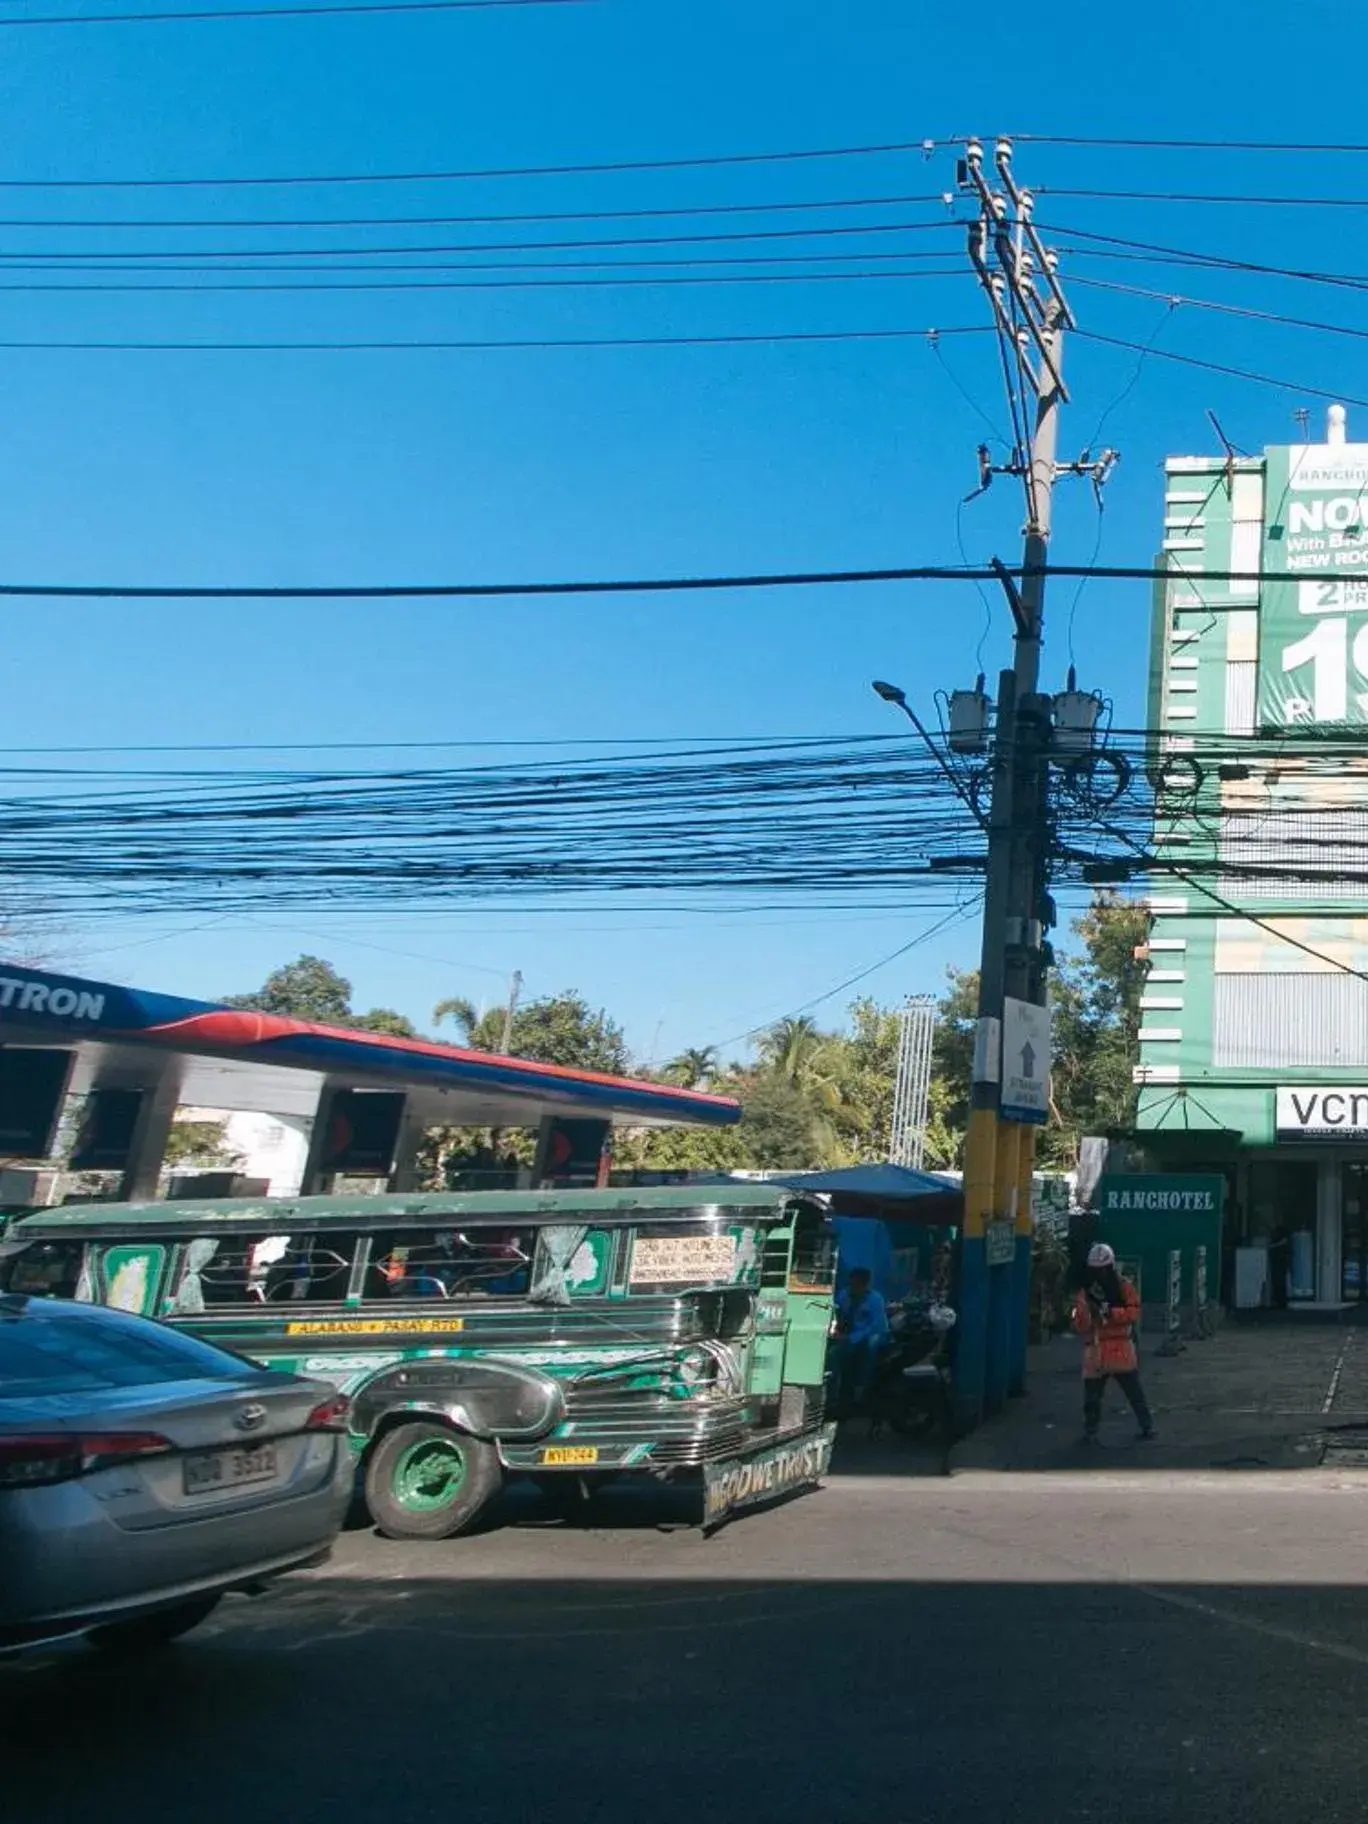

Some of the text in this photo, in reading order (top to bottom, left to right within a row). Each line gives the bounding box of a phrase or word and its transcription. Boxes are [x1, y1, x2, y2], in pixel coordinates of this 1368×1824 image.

[1287, 537, 1325, 551] With
[1287, 553, 1330, 569] NEW
[1316, 582, 1339, 606] 2
[1107, 1190, 1215, 1210] RANCHOTEL
